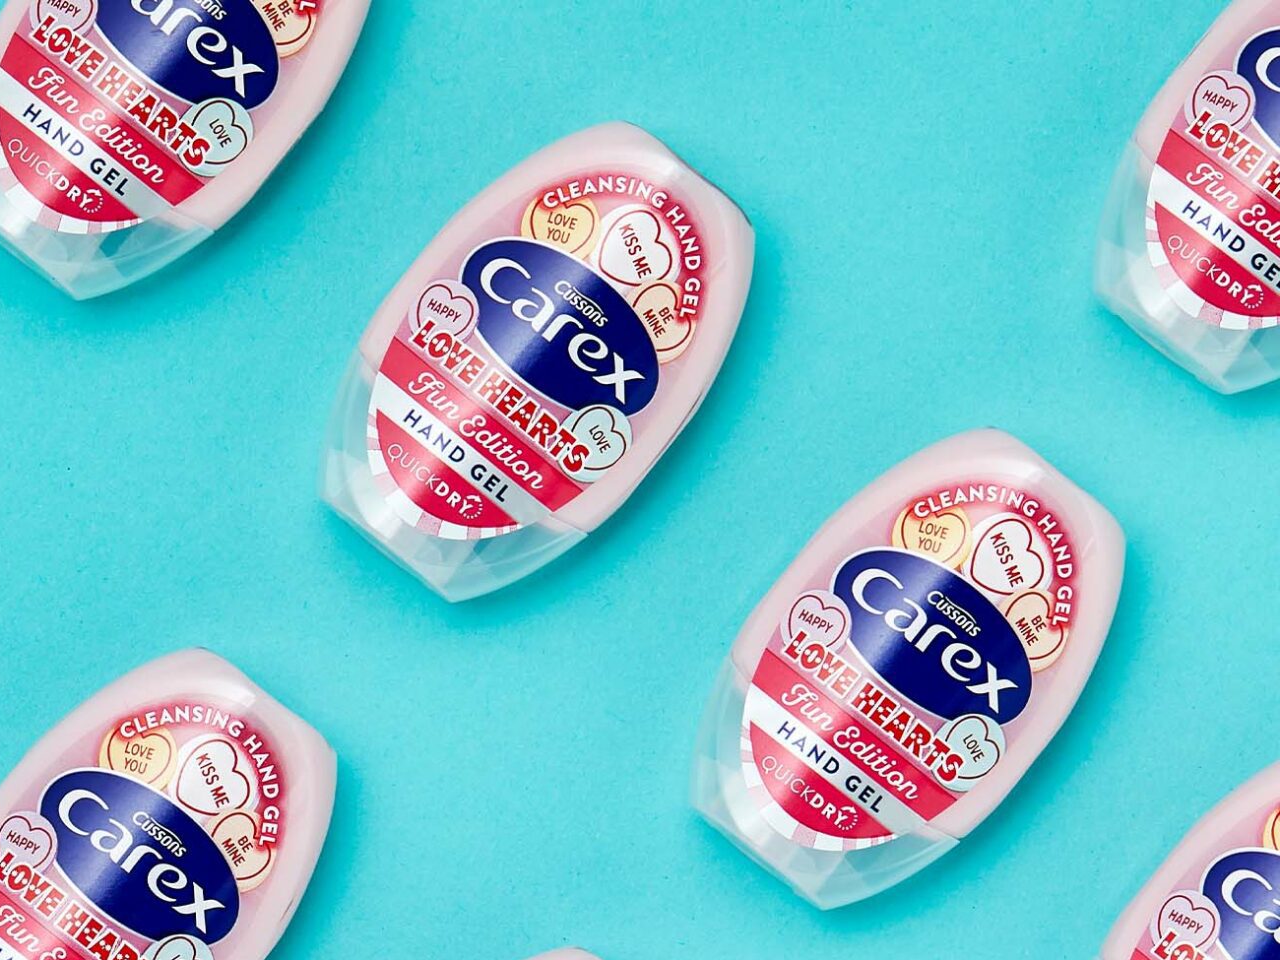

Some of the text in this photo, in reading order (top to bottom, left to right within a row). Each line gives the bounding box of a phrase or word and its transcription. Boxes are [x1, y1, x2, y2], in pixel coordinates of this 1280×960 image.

[262, 3, 285, 32] MINE
[277, 0, 294, 18] BE
[131, 0, 265, 98] arex
[32, 15, 210, 166] LOVE HEARTS
[1202, 89, 1237, 113] HAPPY
[23, 104, 132, 196] HAND GEL
[28, 66, 163, 184] Fun Edition
[209, 118, 231, 147] LOVE
[1189, 110, 1264, 175] LOVE
[1186, 162, 1238, 210] Fun
[543, 176, 701, 318] CLEANSING HAND GEL
[547, 212, 578, 230] LOVE
[547, 227, 571, 244] YOU
[1183, 199, 1245, 254] HAND
[619, 224, 652, 279] KISS ME
[427, 299, 461, 322] HAPPY
[479, 257, 645, 404] Carex
[554, 280, 608, 328] Cussons
[643, 308, 666, 338] MINE
[658, 306, 674, 324] BE
[412, 320, 590, 472] LOVE HEARTS
[403, 409, 512, 503] HAND GEL
[408, 372, 544, 490] Fun Edition
[589, 424, 611, 453] LOVE
[914, 485, 1073, 626] CLEANSING HAND GEL
[991, 533, 1024, 588] KISS ME
[799, 610, 834, 633] HAPPY
[852, 567, 1018, 714] Carex
[927, 589, 980, 638] Cussons
[785, 631, 964, 782] LOVE HEARTS
[777, 720, 886, 813] HAND GEL
[781, 683, 918, 801] Fun Edition
[963, 734, 985, 763] LOVE
[120, 706, 280, 846] CLEANSING HAND GEL
[197, 753, 230, 808] KISS ME
[5, 831, 40, 854] HAPPY
[58, 788, 224, 935] Carex
[133, 810, 187, 858] Cussons
[1169, 910, 1203, 934] HAPPY
